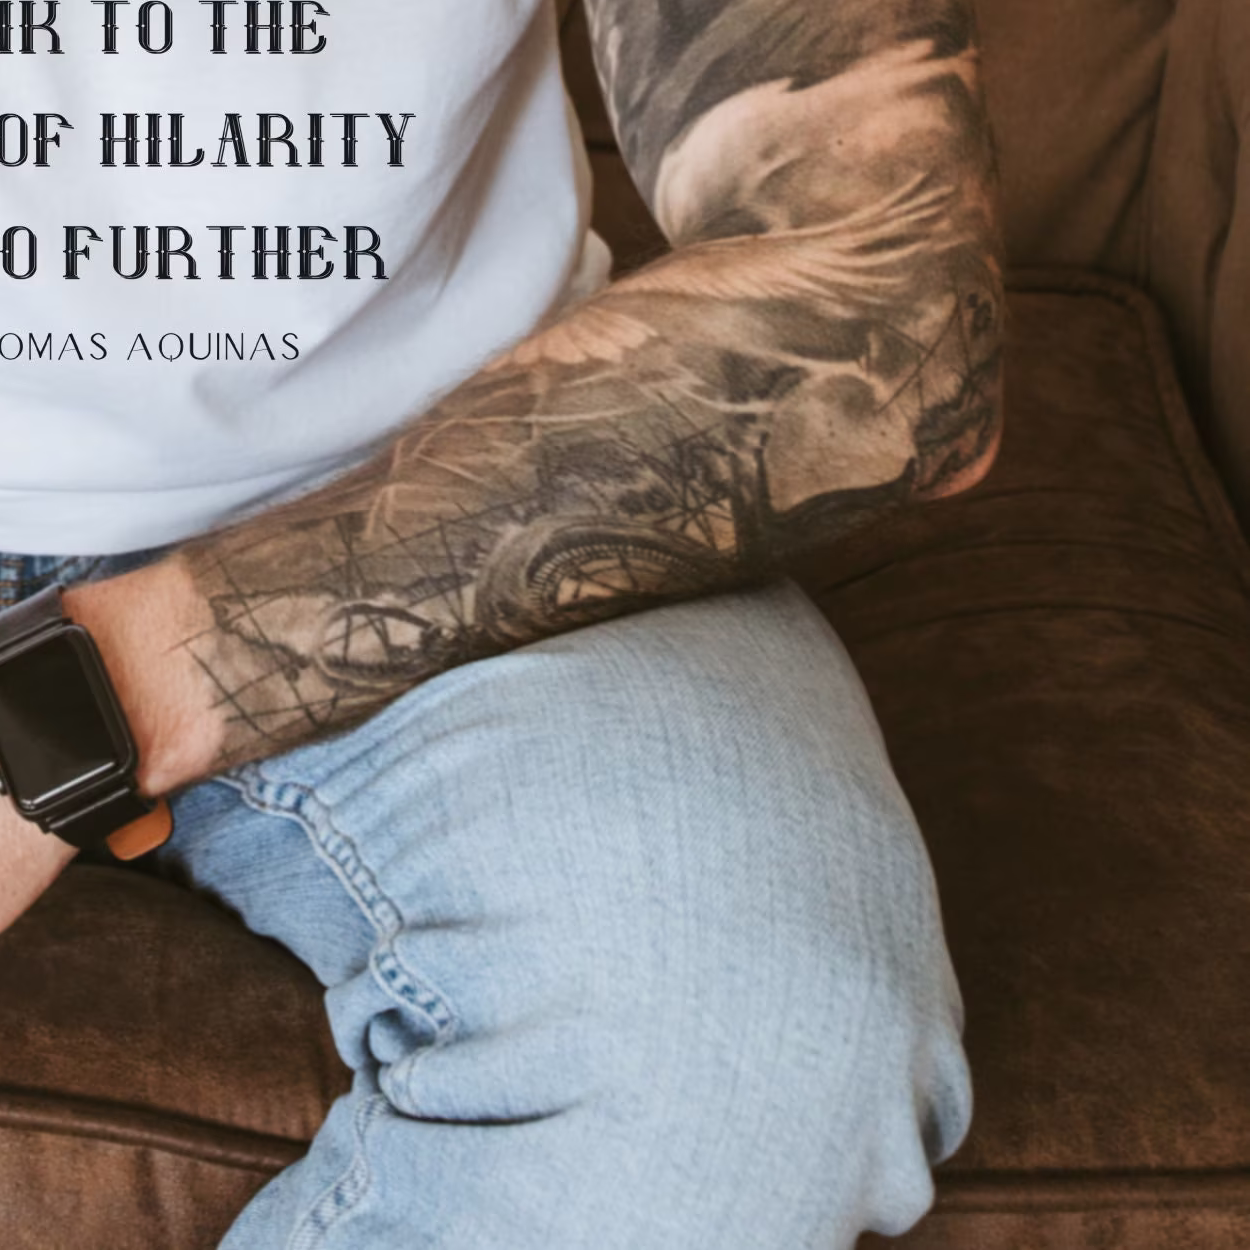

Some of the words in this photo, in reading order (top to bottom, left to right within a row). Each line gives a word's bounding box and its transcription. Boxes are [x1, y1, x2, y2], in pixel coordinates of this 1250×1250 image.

[91, 1, 173, 54] TO
[199, 1, 330, 54] THE
[100, 113, 416, 167] HILARITY
[63, 226, 389, 279] FURTHER
[127, 333, 299, 362] AQUINAS
